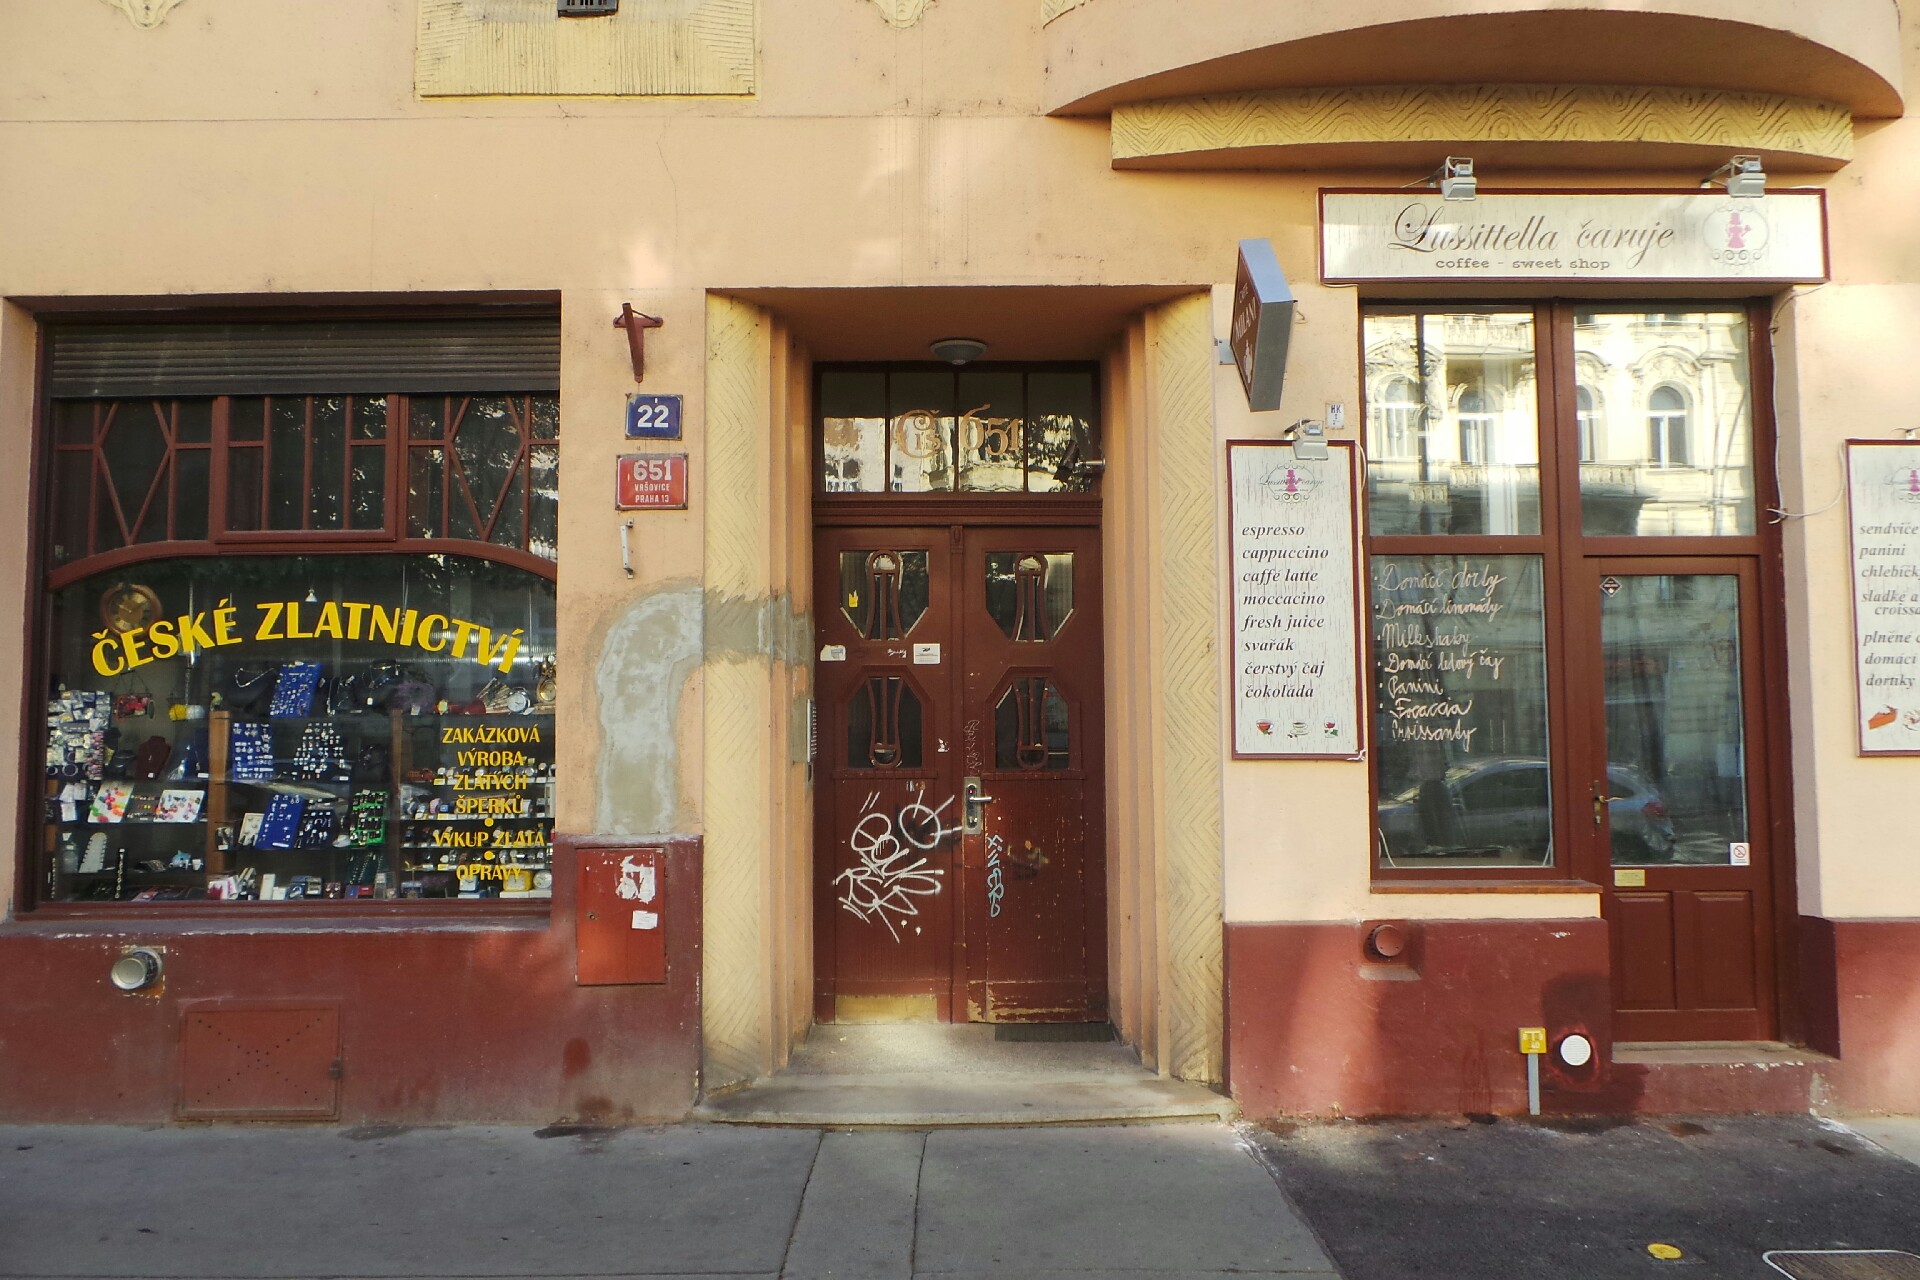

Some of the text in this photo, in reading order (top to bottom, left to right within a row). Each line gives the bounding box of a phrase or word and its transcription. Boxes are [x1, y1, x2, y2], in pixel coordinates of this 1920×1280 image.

[1387, 202, 1675, 270] Lussittella čaruje
[1435, 257, 1490, 270] coffee
[1512, 257, 1562, 270] sweet
[1569, 257, 1611, 271] shop
[637, 404, 669, 428] 22
[960, 403, 1020, 456] 651
[633, 459, 672, 481] 651
[634, 481, 670, 492] VRŠOVICE
[635, 494, 670, 503] PRAHA 13
[1242, 526, 1304, 540] espresso
[1242, 545, 1329, 562] cappuccino
[1859, 543, 1906, 560] panini
[1285, 569, 1318, 582] latte
[1243, 591, 1325, 605] moccacino
[1241, 614, 1325, 632] fresh juice
[92, 599, 523, 676] ČESKÉ ZLATNICTVÍ
[1244, 638, 1294, 651] svařák
[1244, 661, 1325, 678] čerstvý čaj
[1388, 675, 1444, 699] Panini
[442, 724, 540, 744] ZAKÁZKOVÁ
[457, 748, 524, 767] VÝROBA
[452, 771, 528, 791] ZLATÝCH
[455, 795, 524, 815] ŠPERKŮ
[494, 830, 545, 848] ZLATA
